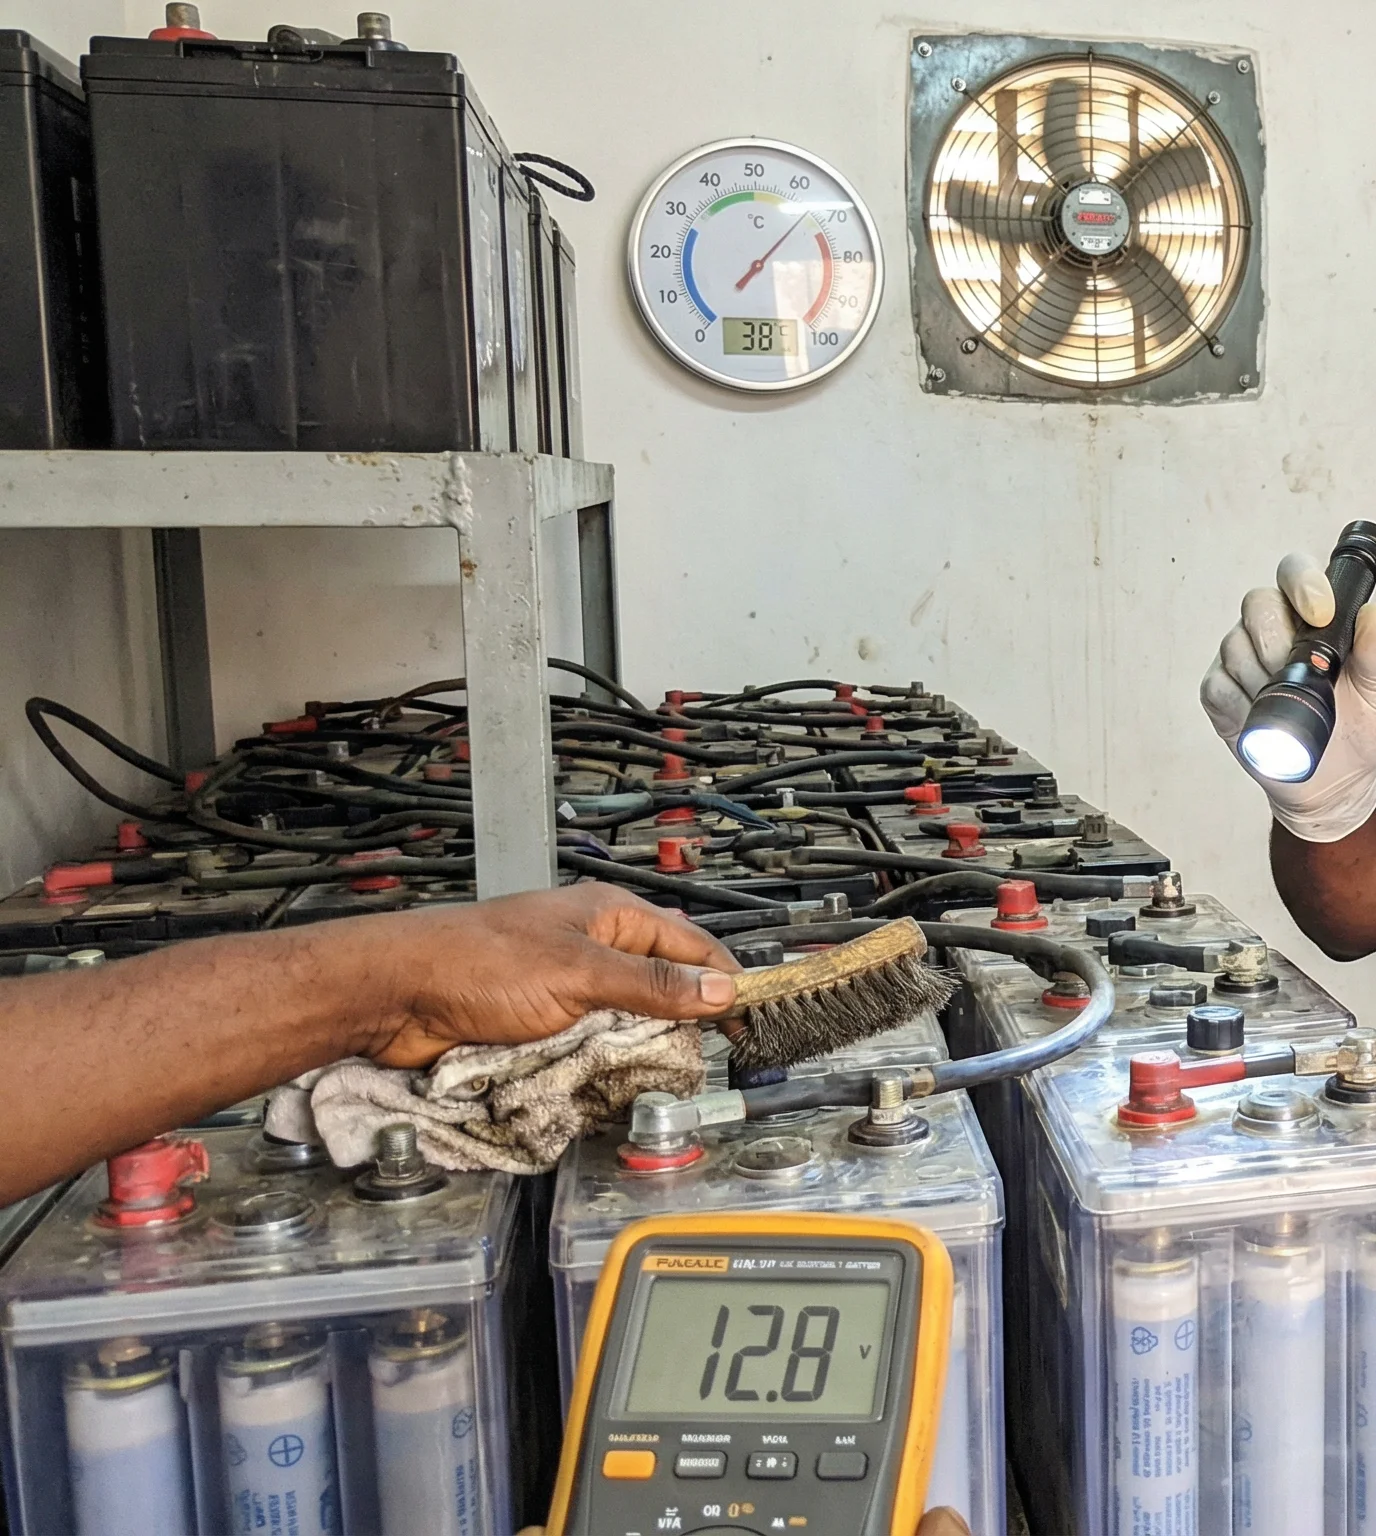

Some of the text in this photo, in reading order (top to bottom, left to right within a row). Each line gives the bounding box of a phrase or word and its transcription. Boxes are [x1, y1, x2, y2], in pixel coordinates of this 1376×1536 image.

[743, 163, 765, 178] 50
[699, 172, 721, 187] 40
[789, 175, 810, 190] 60
[665, 201, 687, 216] 30
[827, 209, 848, 223] 70
[747, 213, 765, 229] °C
[650, 244, 672, 259] 20
[843, 250, 863, 264] 80
[659, 289, 678, 304] 10
[838, 295, 859, 309] 90
[694, 328, 706, 343] 0
[811, 332, 839, 346] 100
[699, 1304, 841, 1402] 12.8
